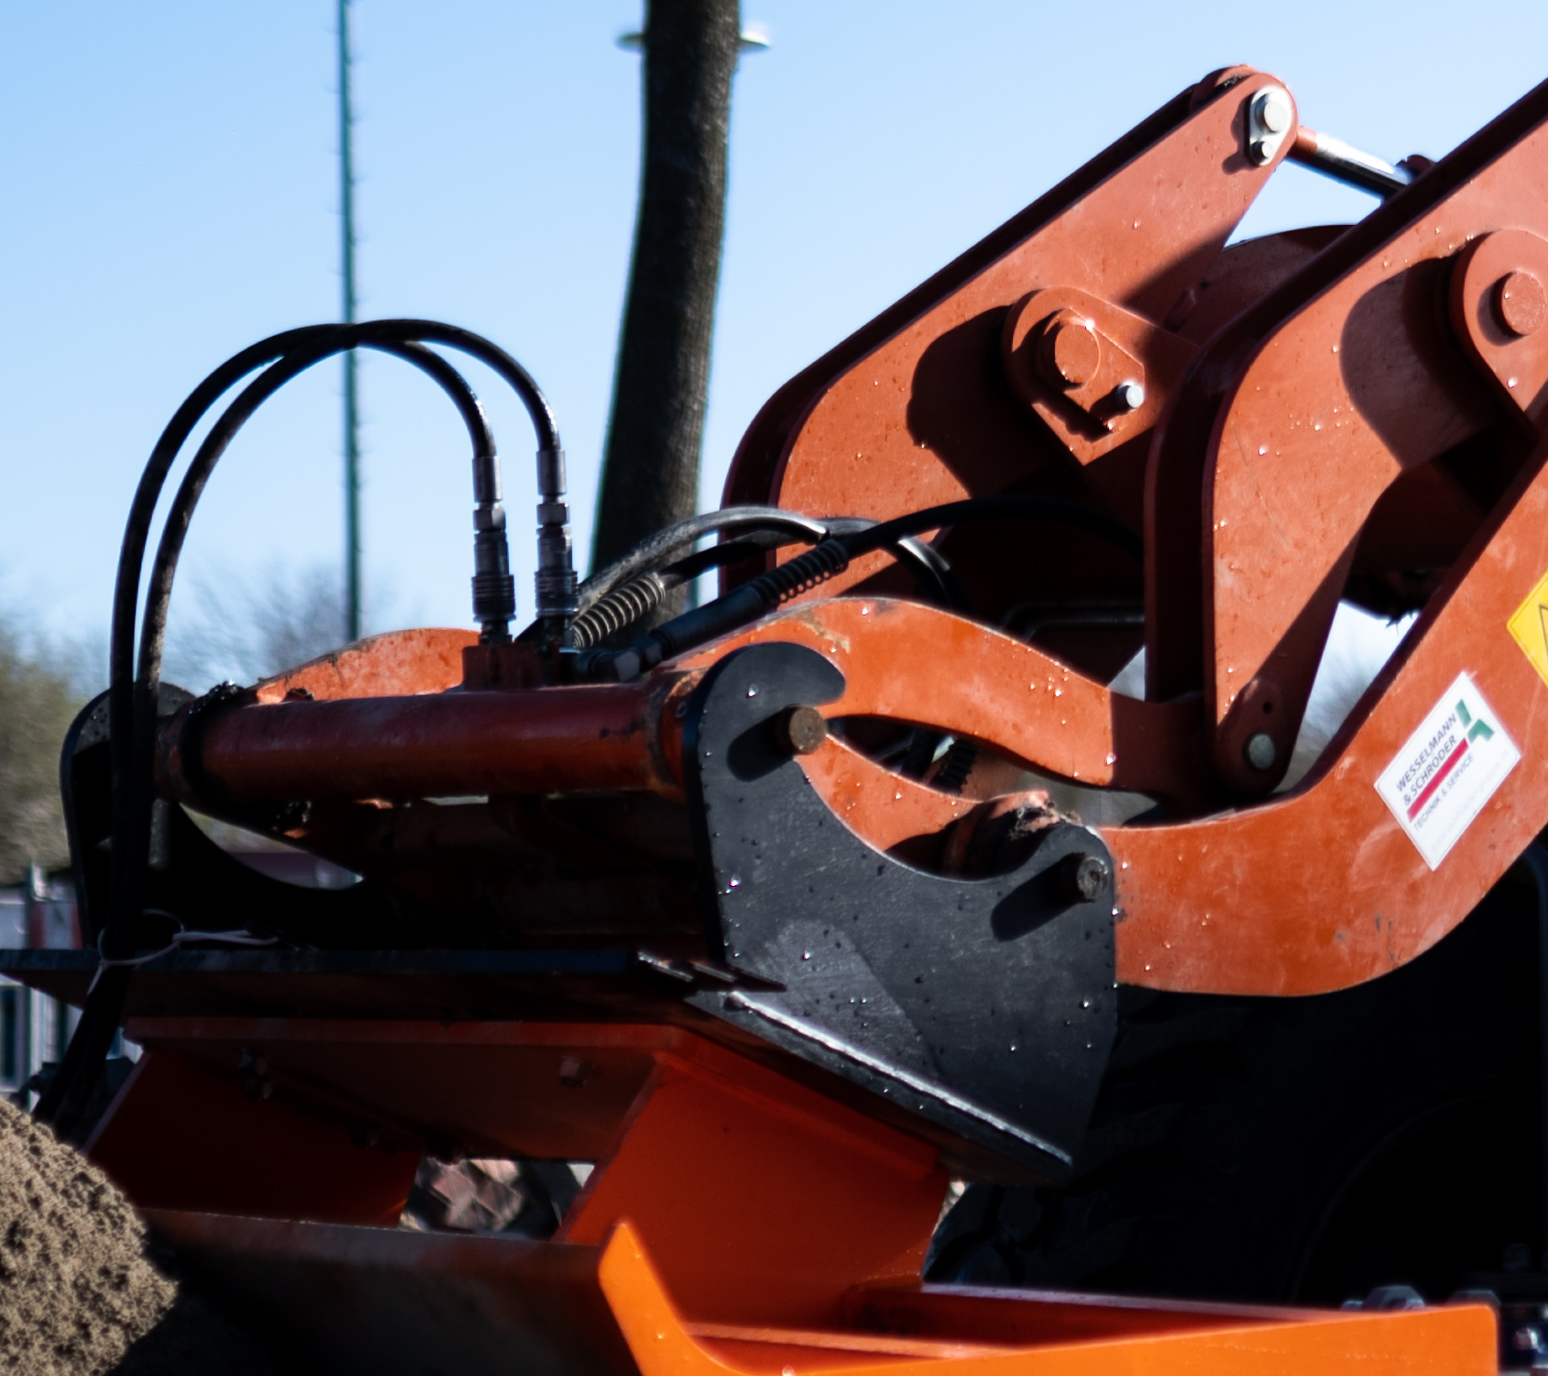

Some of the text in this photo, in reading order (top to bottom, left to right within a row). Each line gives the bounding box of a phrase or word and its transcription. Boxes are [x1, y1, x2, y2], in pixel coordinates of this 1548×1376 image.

[1396, 714, 1457, 792] WESSELMANN
[1414, 796, 1442, 831] TECHNIK
[1447, 753, 1474, 789] SERVICE
[1403, 793, 1412, 806] &
